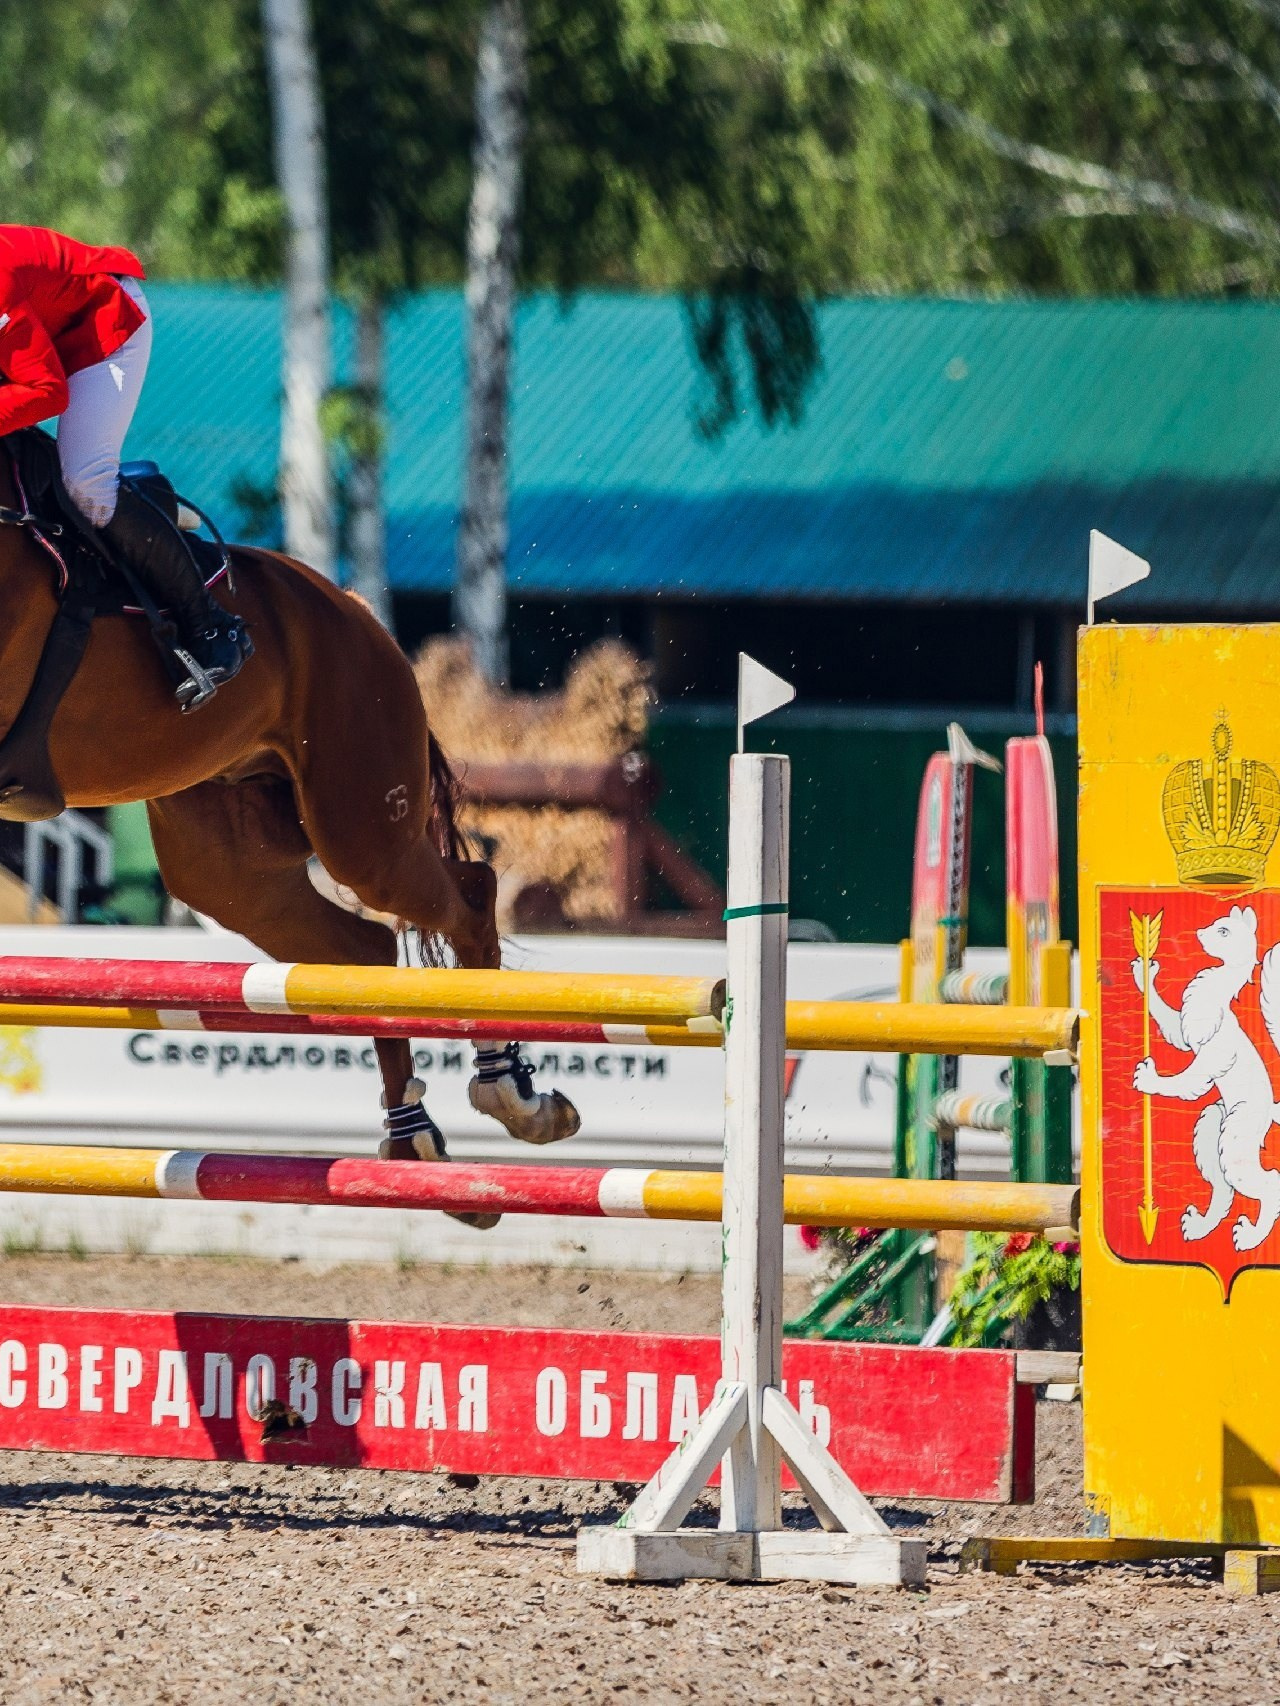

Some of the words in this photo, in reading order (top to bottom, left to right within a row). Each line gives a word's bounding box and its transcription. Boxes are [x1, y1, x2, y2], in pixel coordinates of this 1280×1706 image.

[129, 1032, 463, 1076] Свердловсой
[520, 1046, 667, 1078] ласти
[535, 1365, 832, 1449] ОБЛАЬ
